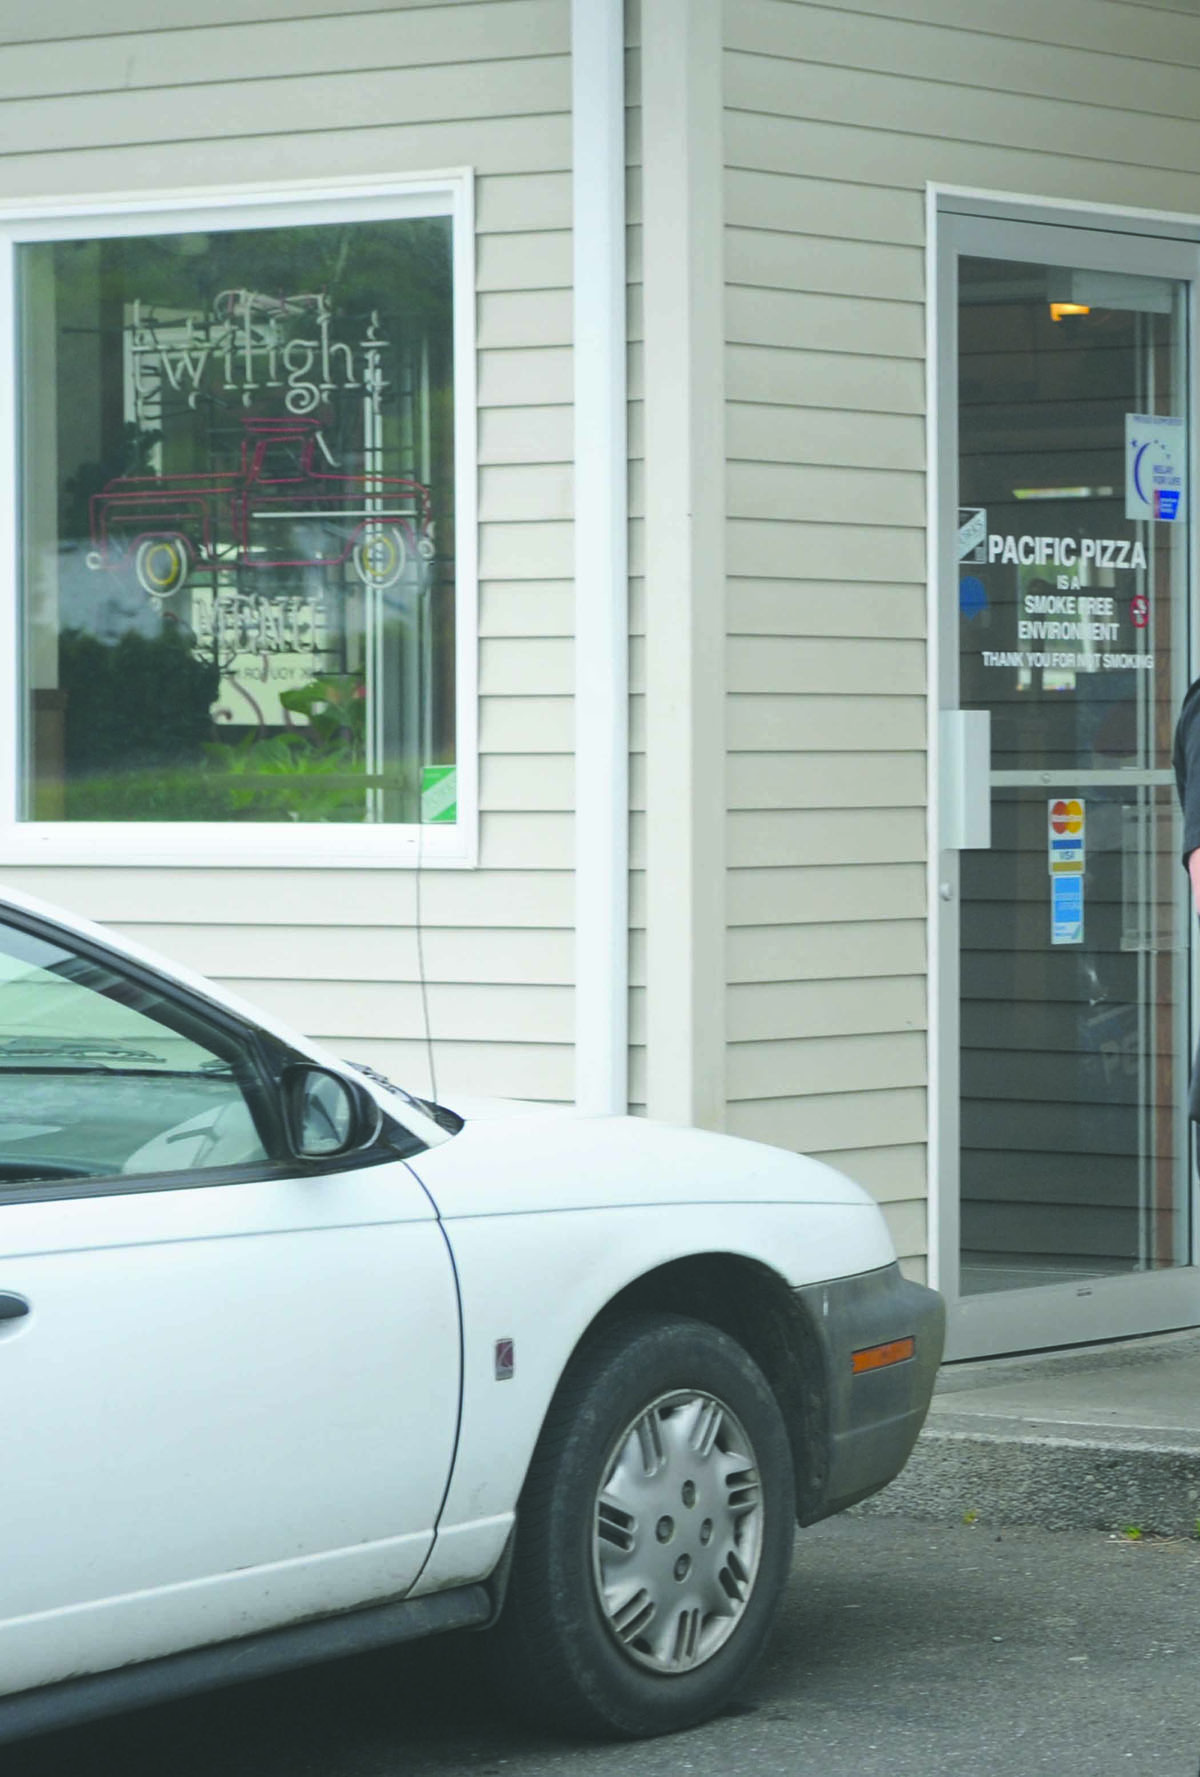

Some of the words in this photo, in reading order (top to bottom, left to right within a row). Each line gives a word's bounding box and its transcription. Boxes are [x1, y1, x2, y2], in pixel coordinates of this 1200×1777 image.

[988, 534, 1077, 567] PACIFIC
[1080, 538, 1147, 569] PIZZA
[1056, 574, 1069, 590] IS
[1070, 575, 1081, 590] A
[1024, 595, 1076, 614] SMOKE
[1017, 620, 1120, 640] ENVIRONENT
[981, 651, 1024, 667] THANK
[1027, 652, 1051, 668] YOU
[1055, 652, 1076, 668] FOR
[1078, 653, 1101, 669] NT
[1102, 654, 1155, 669] SMOKING
